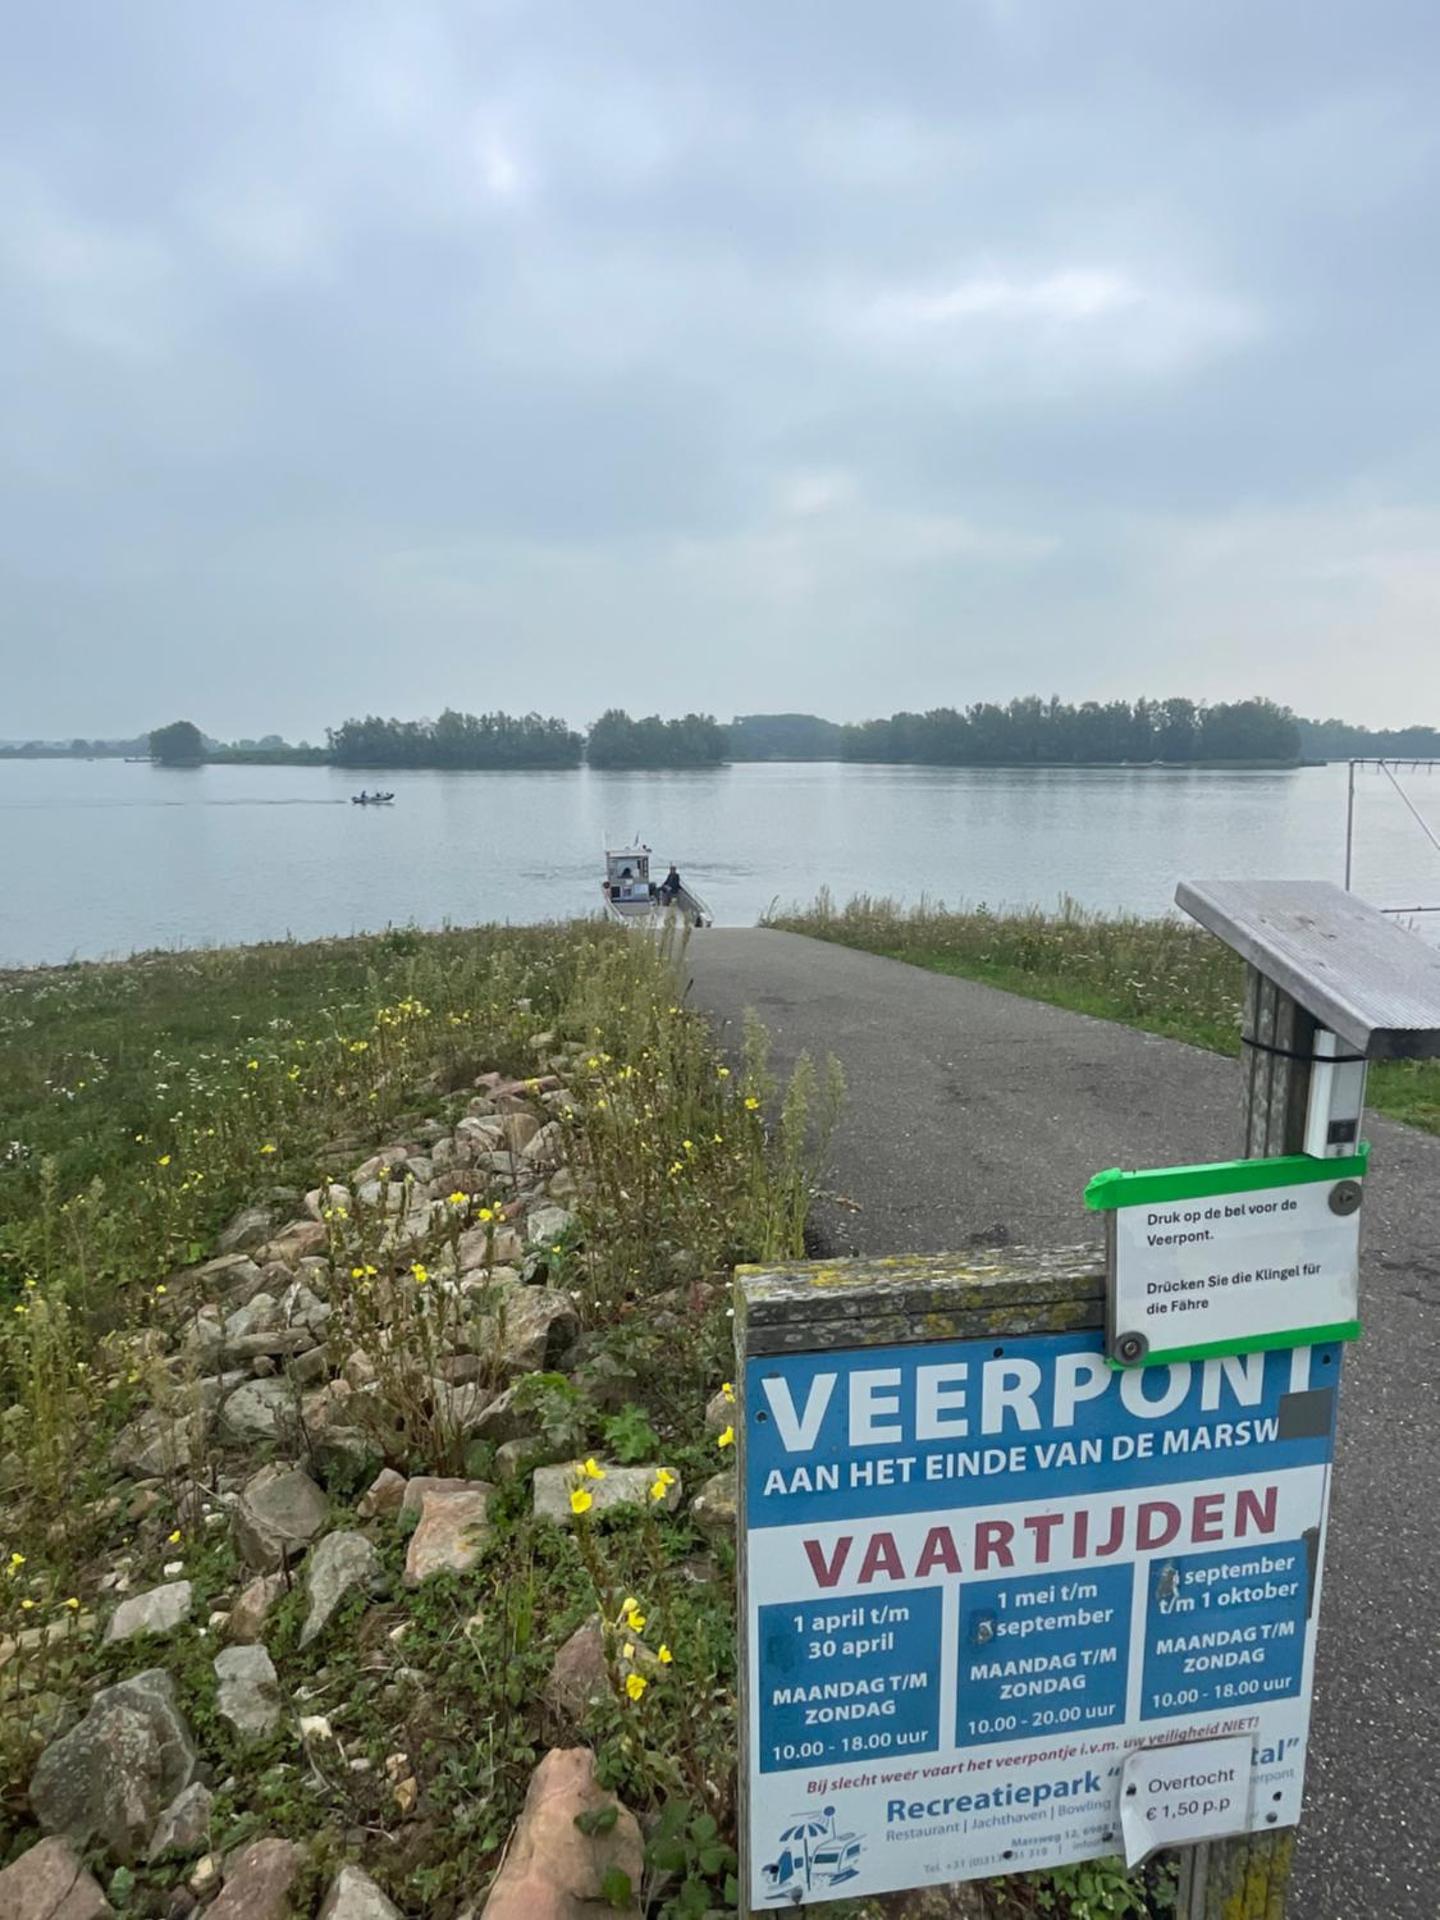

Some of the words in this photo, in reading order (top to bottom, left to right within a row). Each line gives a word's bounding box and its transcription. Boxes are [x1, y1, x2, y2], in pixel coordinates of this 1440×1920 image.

[1147, 1211, 1180, 1226] Druk
[1184, 1212, 1201, 1223] op
[1204, 1208, 1221, 1220] de
[1225, 1203, 1245, 1217] bel
[1249, 1202, 1277, 1214] voor
[1281, 1199, 1297, 1210] de
[1147, 1230, 1214, 1246] Veerpont.
[1147, 1277, 1205, 1294] Drücken
[1208, 1275, 1229, 1288] Sie
[1232, 1272, 1252, 1284] die
[1255, 1264, 1300, 1281] Klingel
[1303, 1262, 1322, 1275] für
[1147, 1302, 1167, 1315] die
[1171, 1298, 1209, 1312] Fähre
[763, 1464, 839, 1496] AAN
[850, 1457, 916, 1488] HET
[926, 1446, 1026, 1480] EINDE
[1034, 1438, 1102, 1469] VAN
[1112, 1433, 1153, 1462] DE
[1162, 1417, 1280, 1455] MARSW
[804, 1486, 1278, 1588] VAARTIJDEN
[1184, 1556, 1295, 1585] september
[998, 1592, 1007, 1609] 1
[1015, 1585, 1055, 1607] mei
[1061, 1582, 1098, 1601] t/m
[1159, 1593, 1195, 1614] t/m
[1201, 1591, 1210, 1608] 1
[1217, 1581, 1298, 1606] oktober
[793, 1615, 803, 1633] 1
[812, 1608, 864, 1634] april
[870, 1605, 909, 1625] t/m
[996, 1608, 1114, 1638] september
[808, 1640, 836, 1659] 30
[842, 1632, 894, 1658] april
[1156, 1627, 1257, 1655] MAANDAG
[1261, 1620, 1295, 1639] T/M
[970, 1653, 1077, 1680] MAANDAG
[1080, 1647, 1117, 1666] T/M
[1183, 1648, 1265, 1673] ZONDAG
[773, 1678, 885, 1706] MAANDAG
[889, 1672, 928, 1691] T/M
[1000, 1674, 1086, 1700] ZONDAG
[1153, 1688, 1198, 1708] 10.00
[1214, 1679, 1259, 1699] 18.00
[1263, 1676, 1292, 1690] uur
[805, 1700, 896, 1725] ZONDAG
[968, 1715, 1016, 1735] 10.00
[1032, 1706, 1081, 1727] 20.00
[1086, 1703, 1116, 1718] uur
[773, 1741, 824, 1761] 10.00
[841, 1732, 891, 1752] 18.00
[896, 1730, 929, 1745] uur
[807, 1779, 828, 1796] Bij
[830, 1775, 877, 1792] slecht
[881, 1769, 919, 1784] weer
[922, 1765, 964, 1779] vaart
[967, 1758, 992, 1772] het
[995, 1743, 1077, 1770] veerpontje
[1080, 1740, 1119, 1754] i.v.m.
[1123, 1737, 1145, 1749] uw
[1148, 1721, 1219, 1747] veiligheid
[1221, 1716, 1260, 1733] NIET!
[887, 1767, 1101, 1823] Recreatiepark
[1148, 1768, 1235, 1793] Overtocht
[886, 1822, 959, 1842] Restaurant
[972, 1809, 1047, 1830] Jachthaven
[1058, 1800, 1111, 1817] Bowling
[1146, 1806, 1157, 1821] €
[1162, 1803, 1199, 1820] 1,50
[1203, 1797, 1230, 1816] p.p
